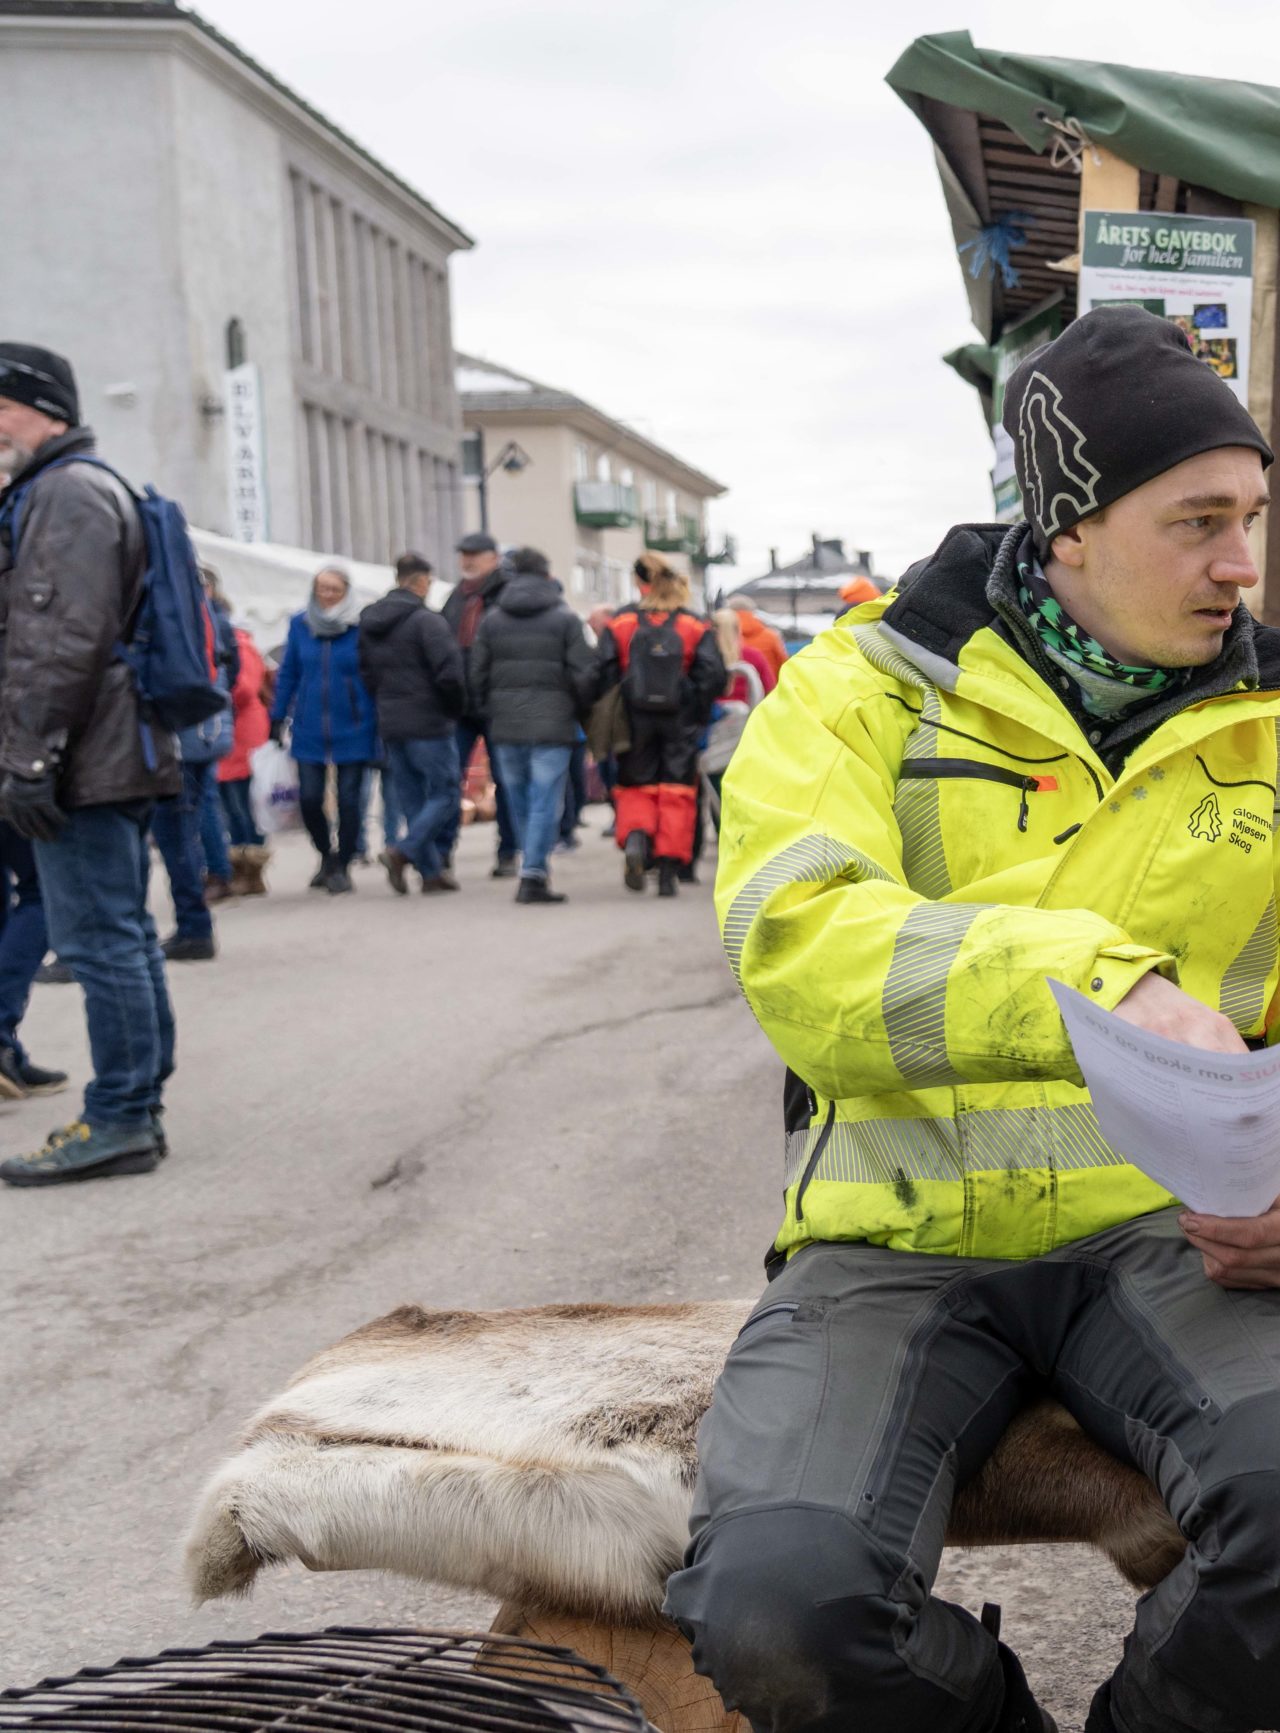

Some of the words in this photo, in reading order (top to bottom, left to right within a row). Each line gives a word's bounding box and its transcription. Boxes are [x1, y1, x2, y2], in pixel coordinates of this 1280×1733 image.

[1096, 218, 1151, 247] ÅRETS
[1154, 228, 1237, 254] GAVEBOK
[1120, 245, 1147, 267] for
[1148, 245, 1180, 265] hele
[1178, 248, 1243, 271] familien
[1232, 818, 1267, 842] Mjøsen
[1228, 832, 1252, 854] Skog
